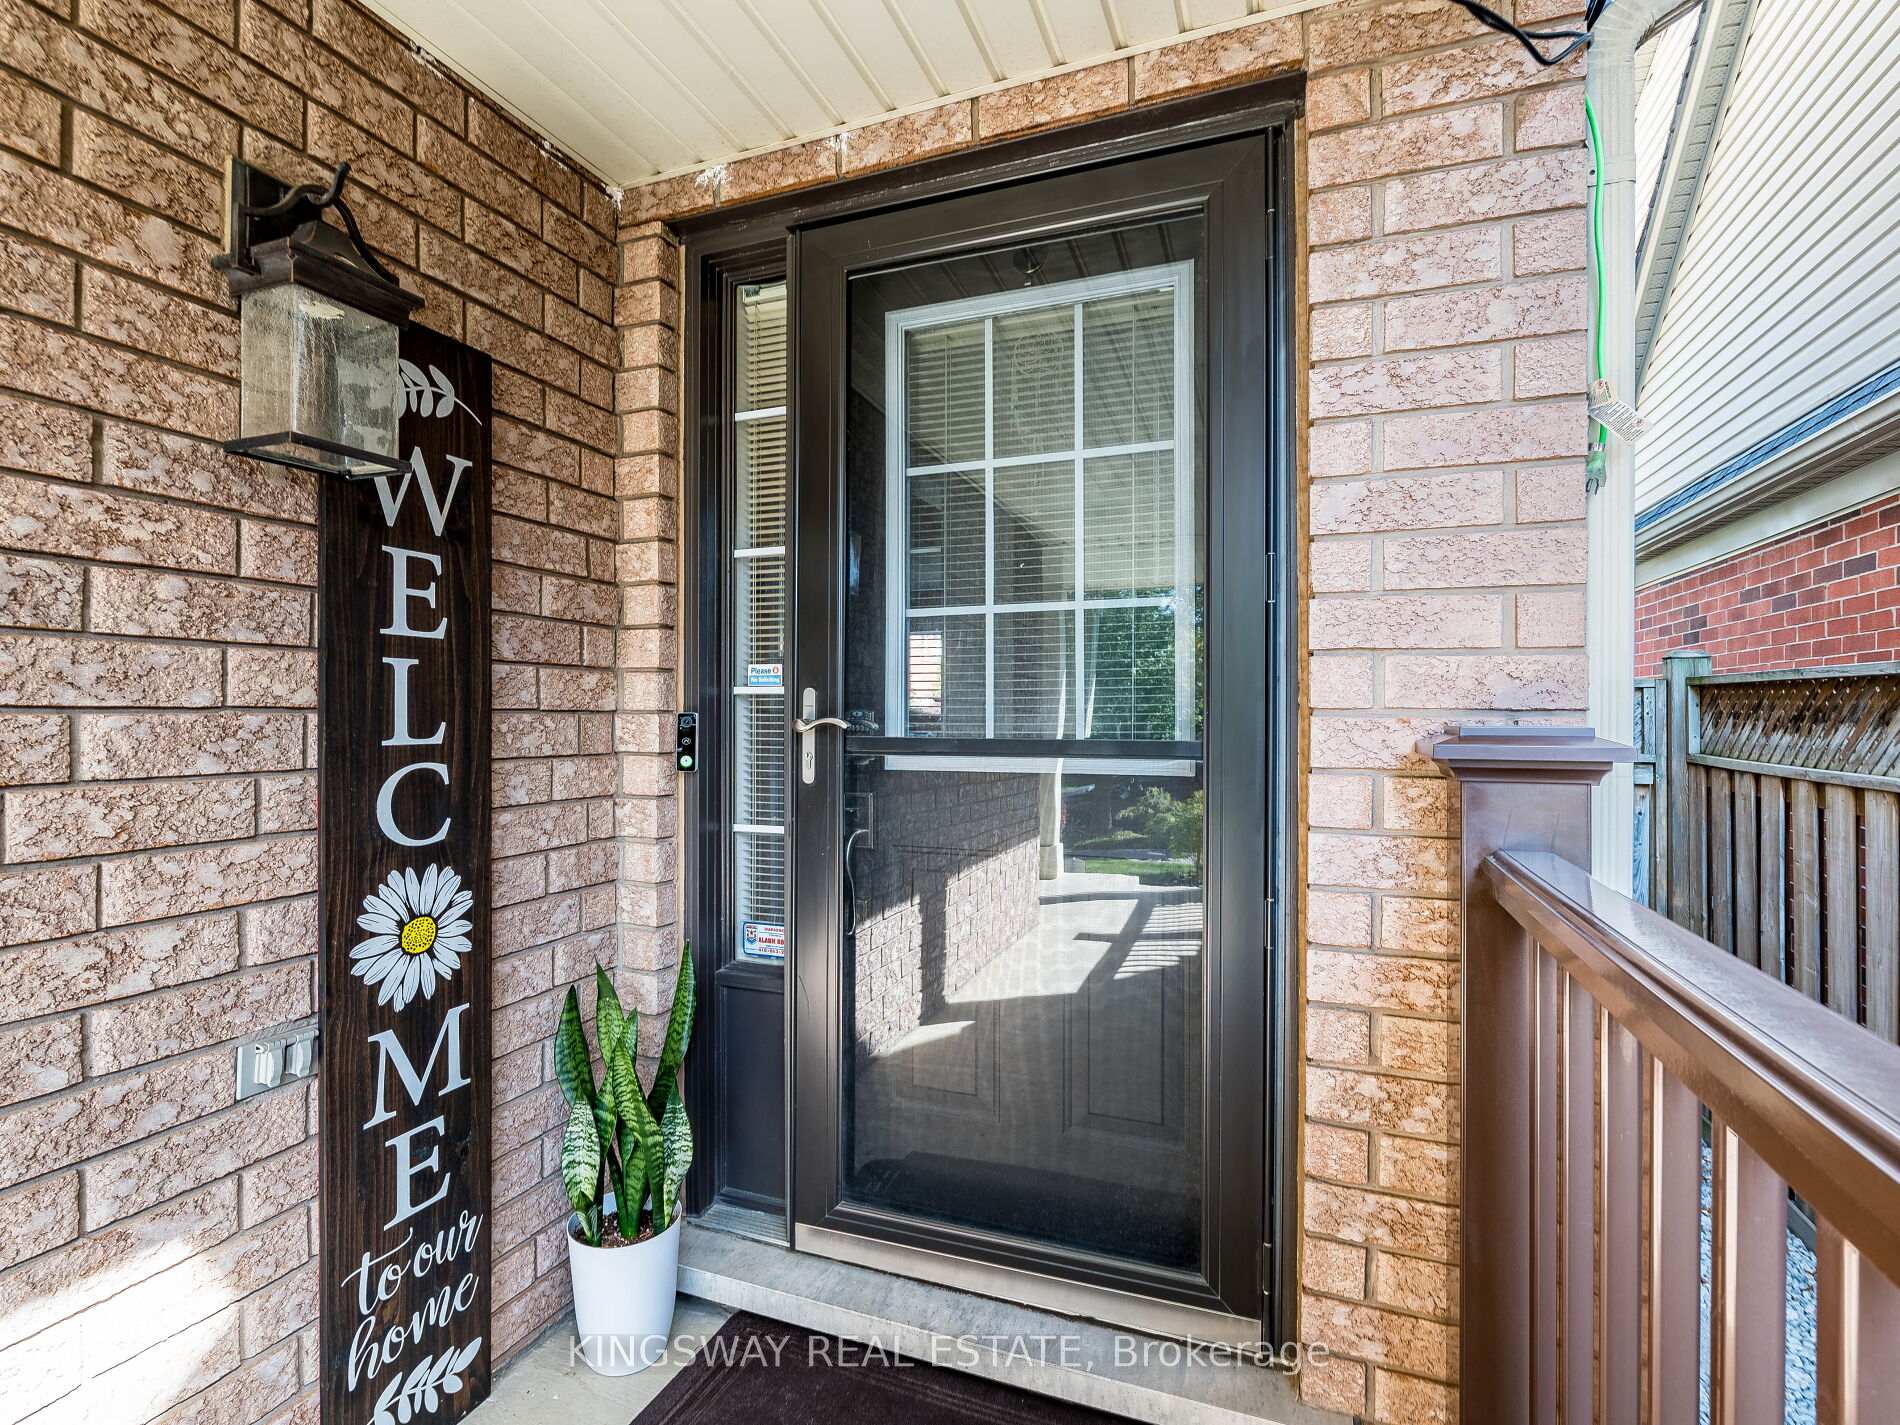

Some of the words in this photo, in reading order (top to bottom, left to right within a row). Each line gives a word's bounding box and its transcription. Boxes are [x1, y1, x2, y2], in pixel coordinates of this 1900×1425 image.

[350, 446, 473, 1231] WELCME
[341, 1226, 413, 1315] to
[413, 1210, 483, 1277] our
[347, 1273, 480, 1392] home
